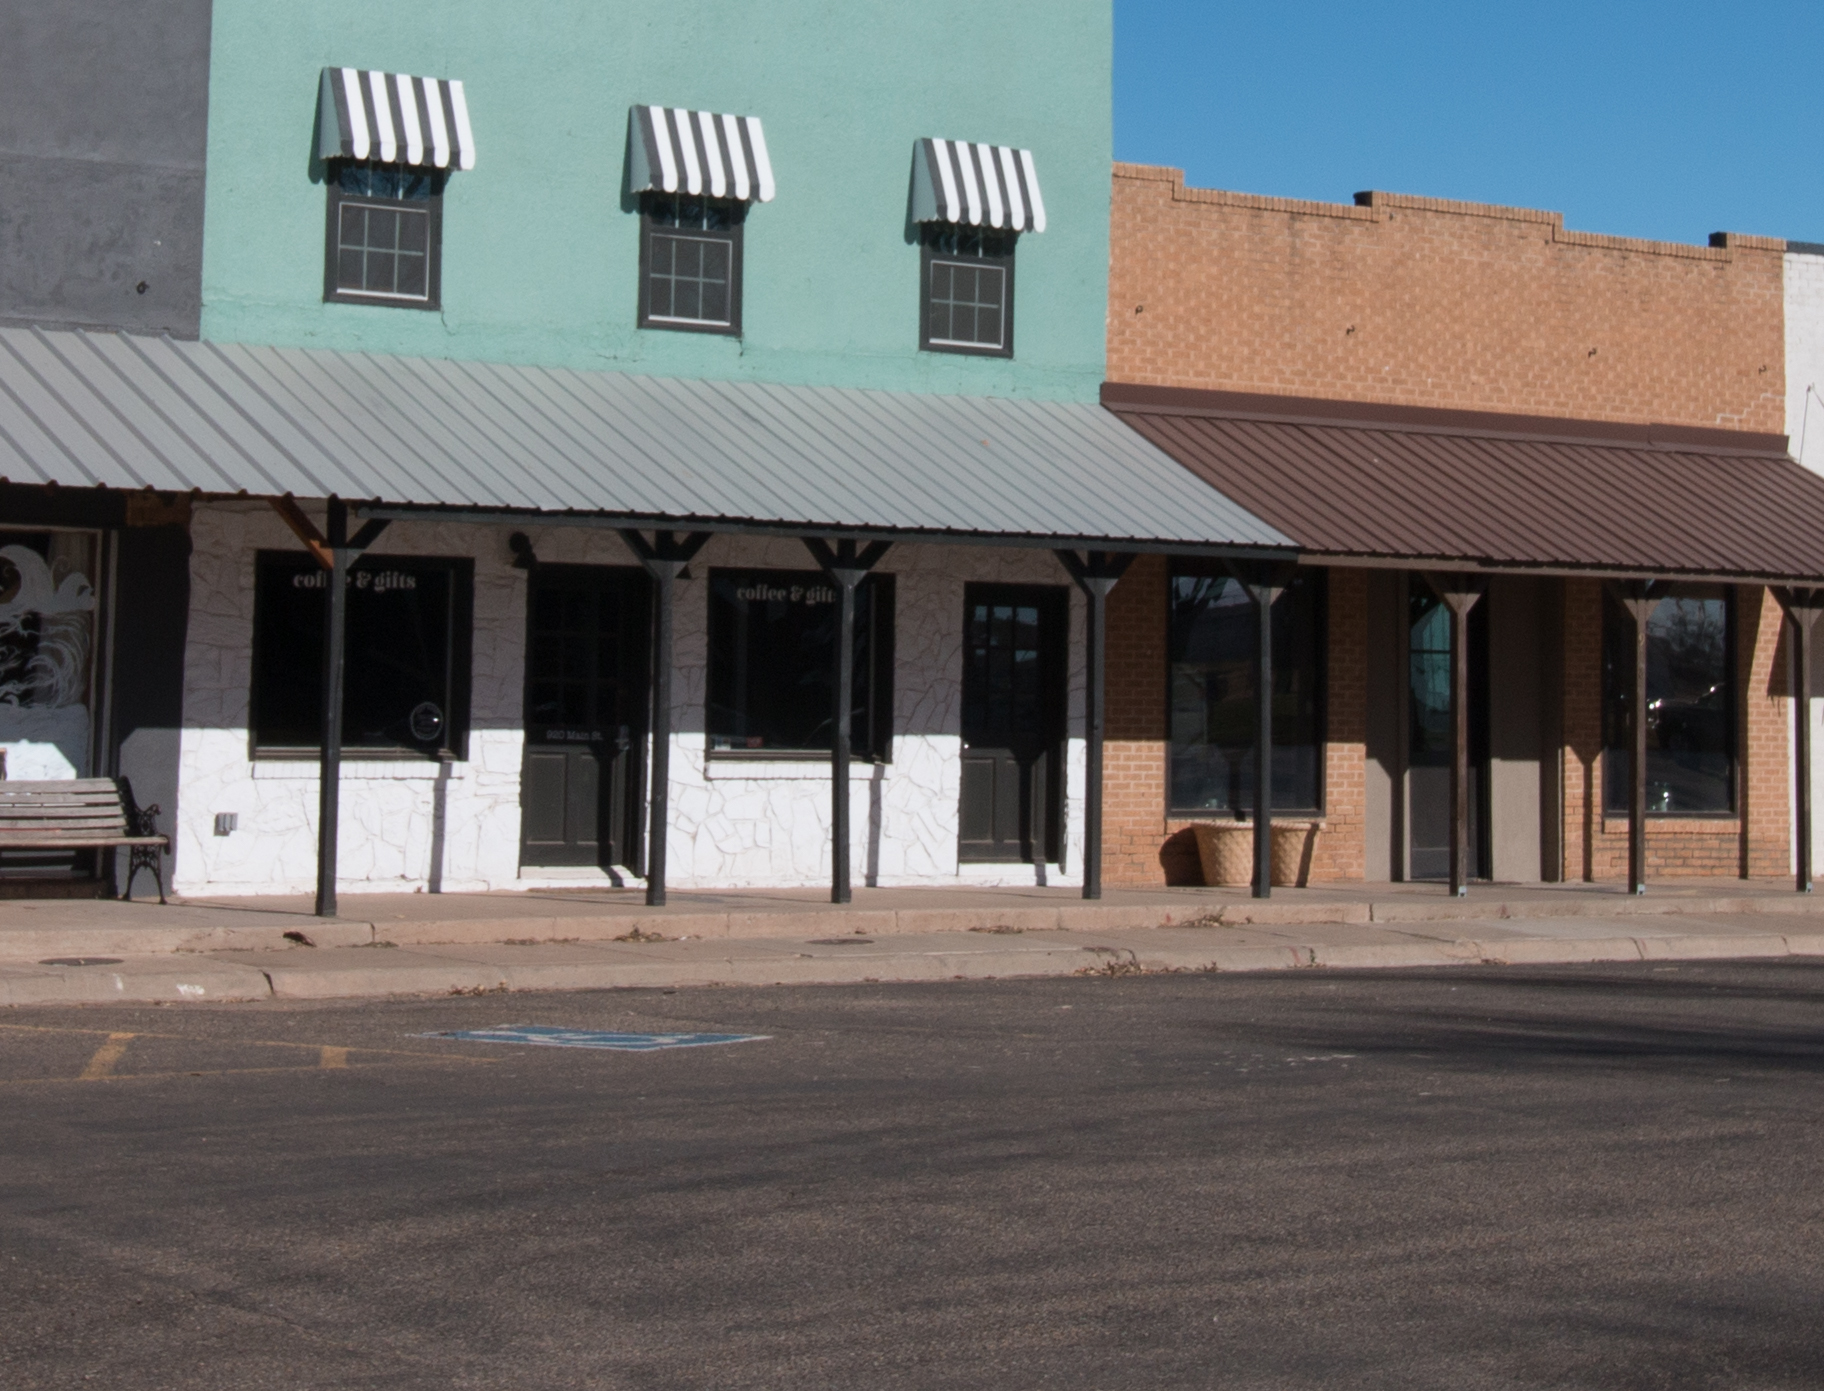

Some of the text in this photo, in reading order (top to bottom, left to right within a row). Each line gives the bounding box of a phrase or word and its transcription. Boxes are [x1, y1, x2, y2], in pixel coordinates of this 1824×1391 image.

[355, 570, 372, 590] &
[374, 570, 416, 594] gifts
[736, 583, 788, 602] coffee
[789, 584, 805, 603] &
[566, 729, 590, 741] Main
